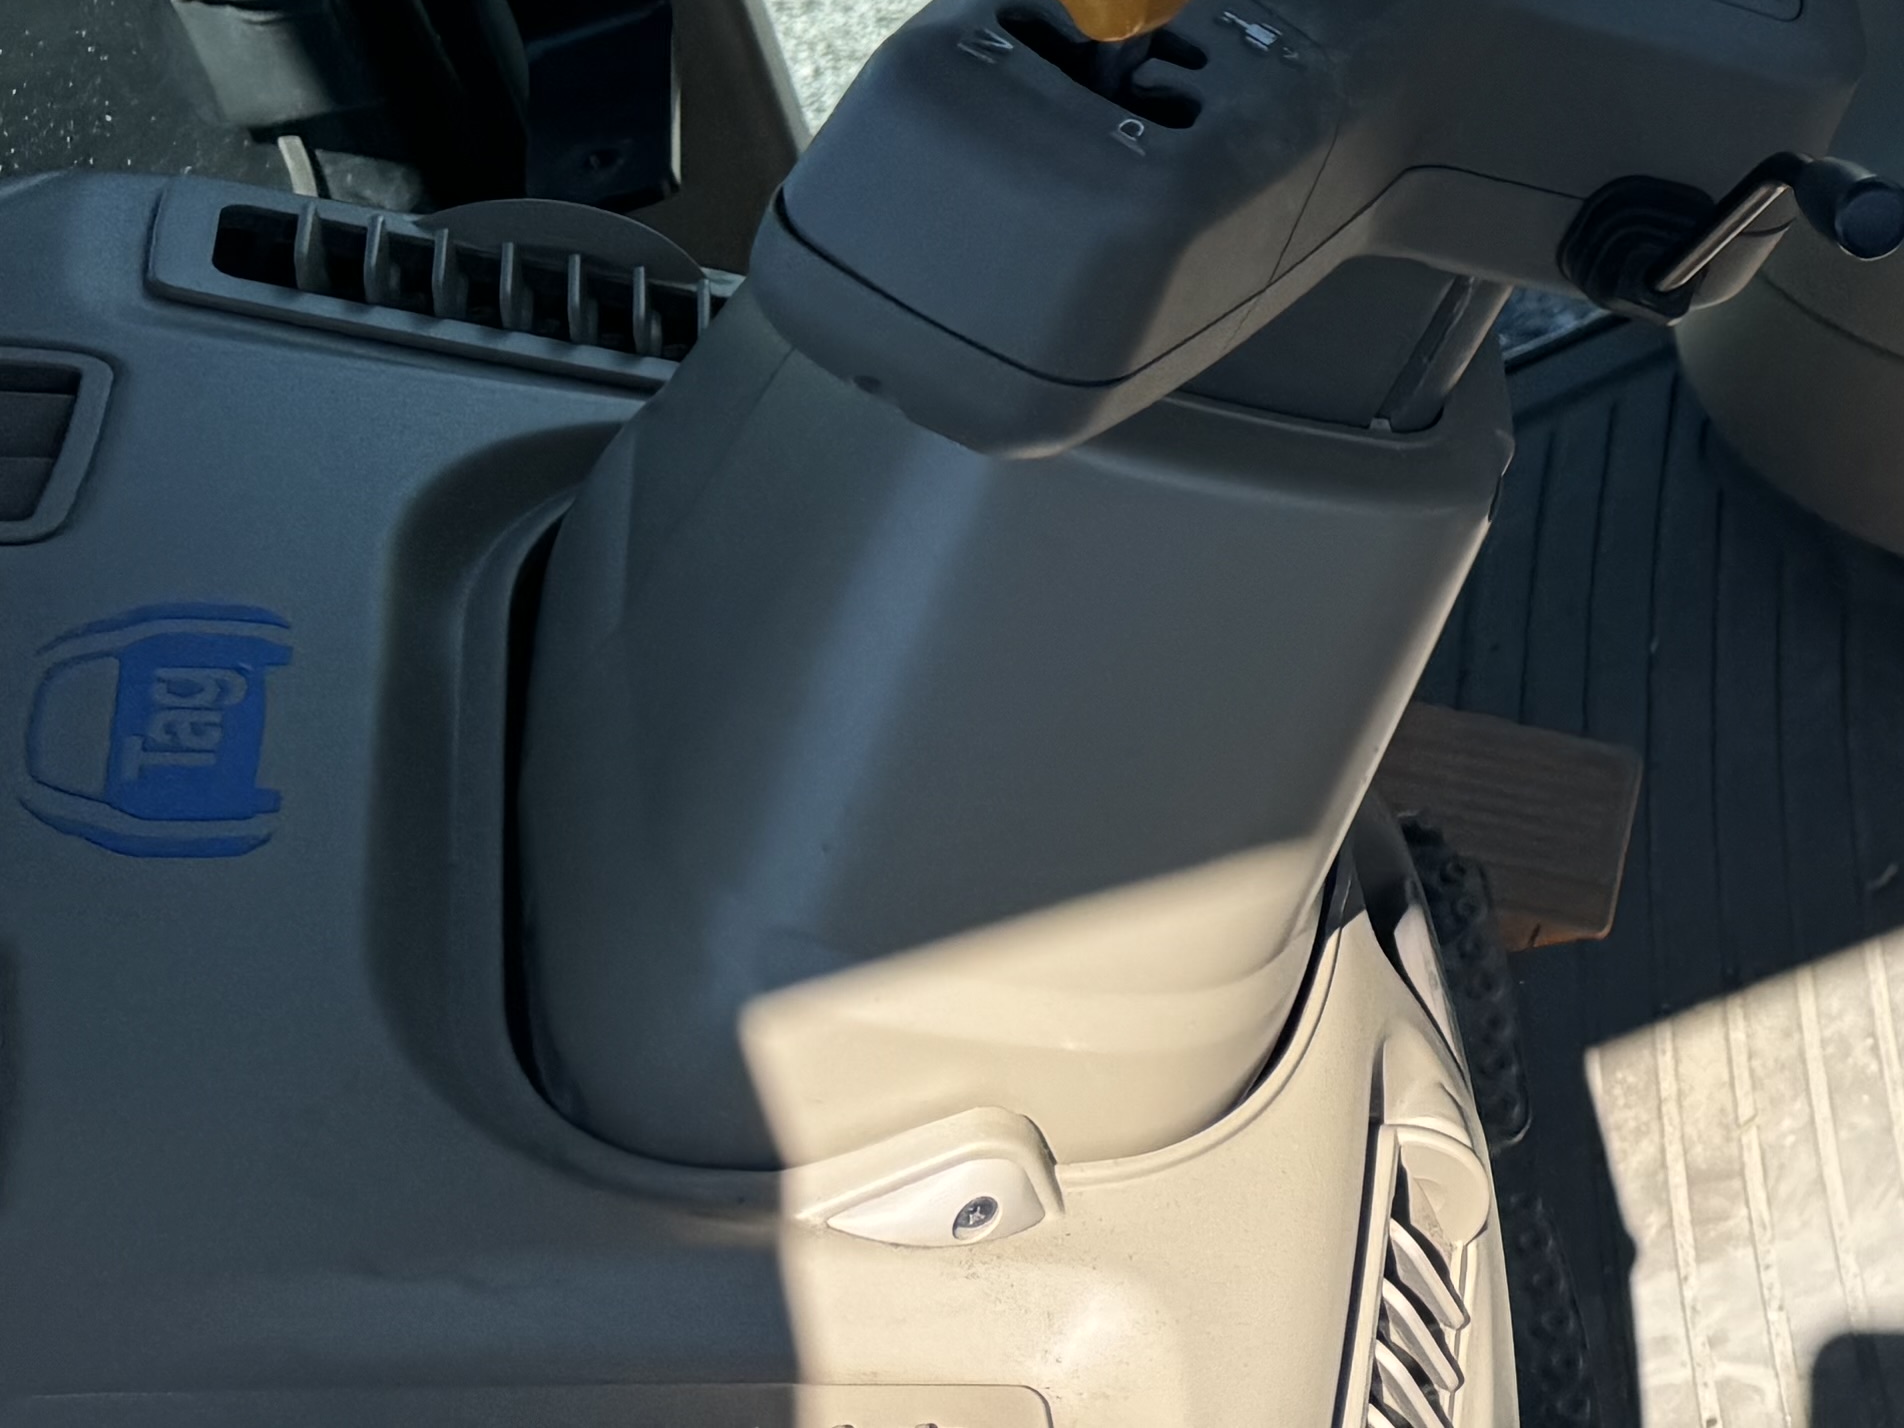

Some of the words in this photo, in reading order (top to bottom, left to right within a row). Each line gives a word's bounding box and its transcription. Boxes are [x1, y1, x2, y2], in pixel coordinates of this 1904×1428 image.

[955, 26, 1016, 65] N
[1108, 117, 1147, 158] P
[119, 666, 250, 782] Tag
